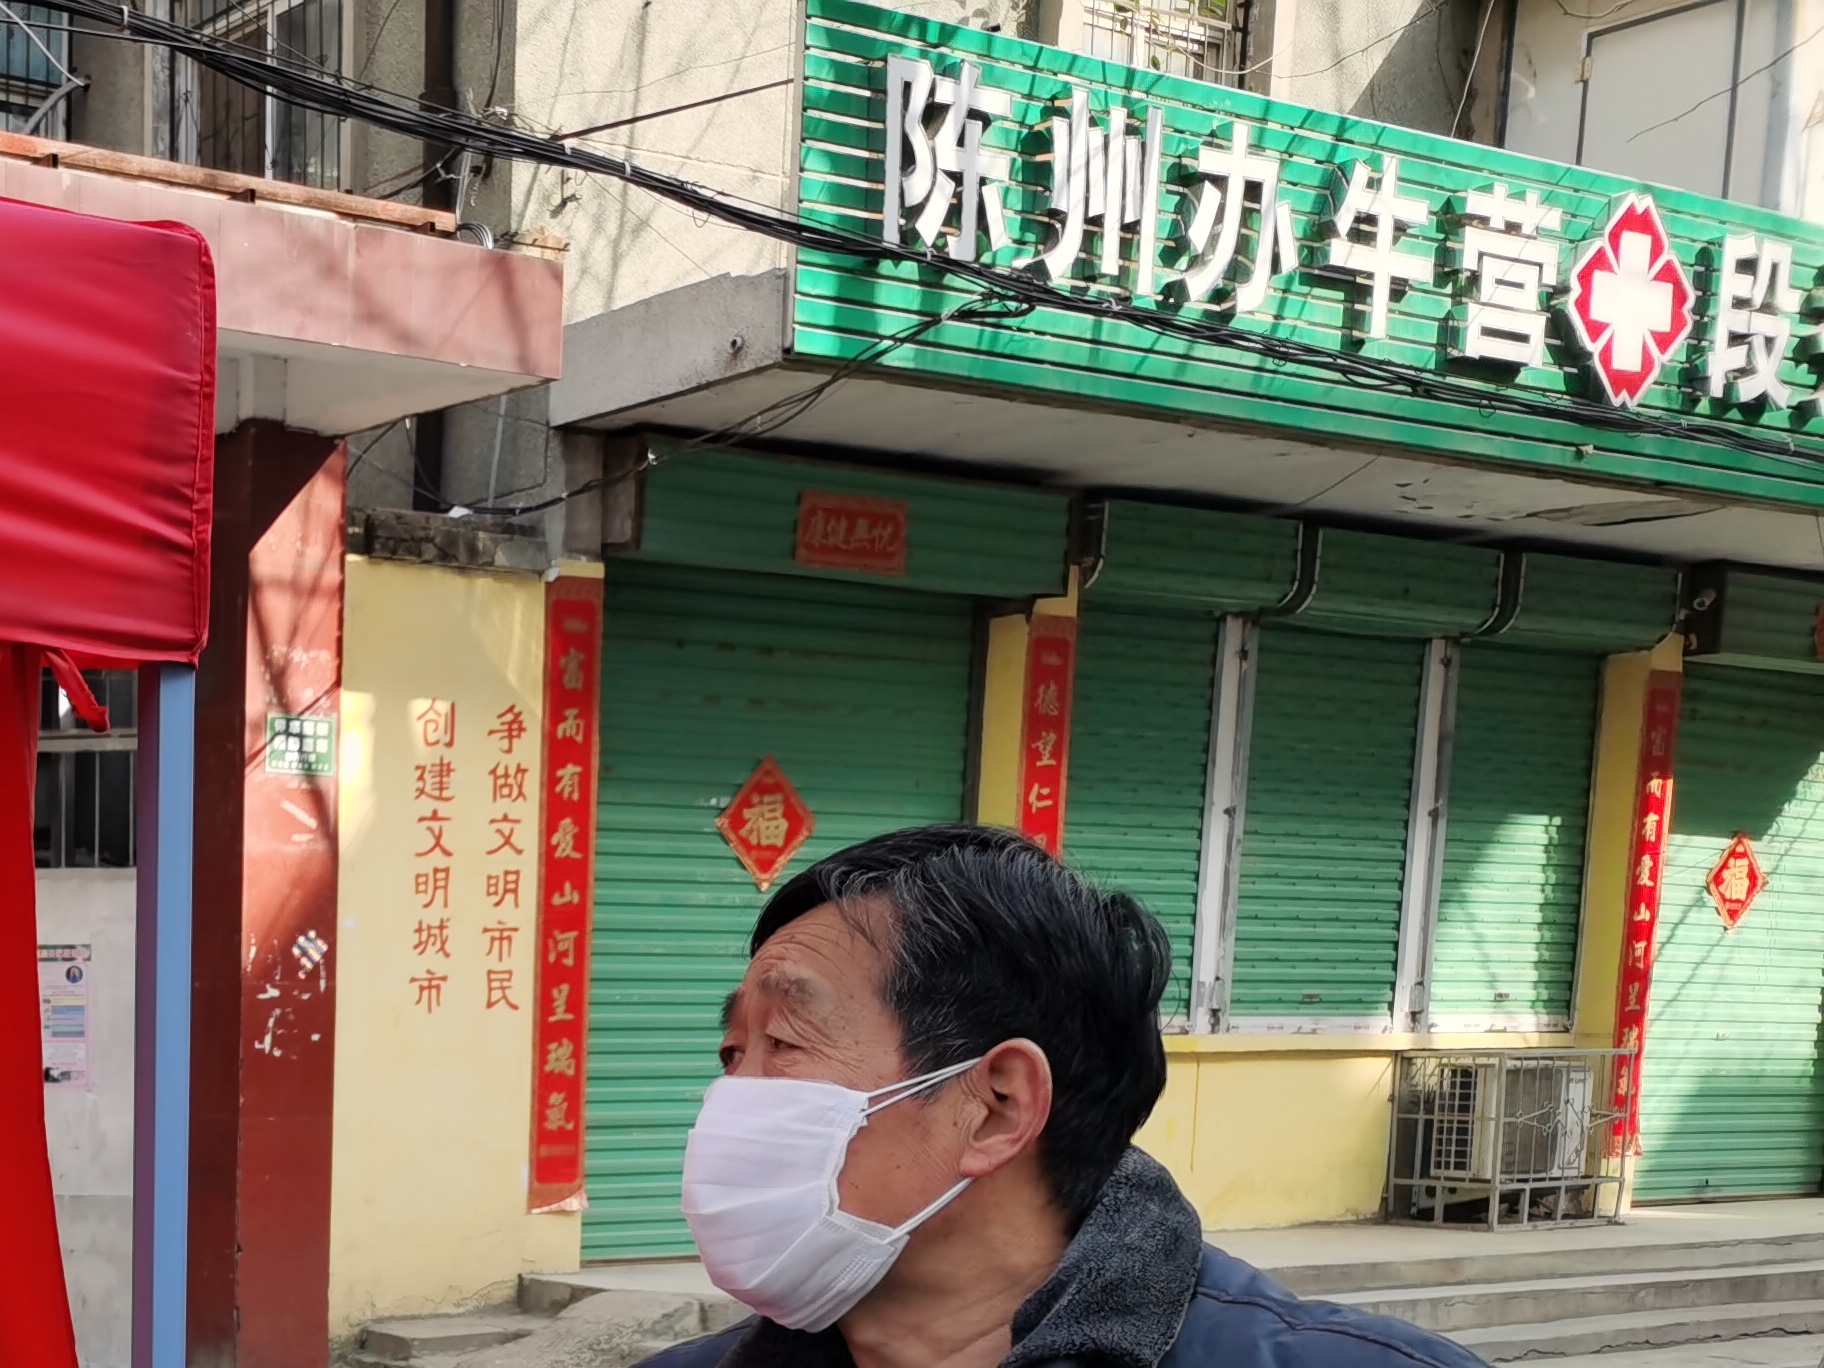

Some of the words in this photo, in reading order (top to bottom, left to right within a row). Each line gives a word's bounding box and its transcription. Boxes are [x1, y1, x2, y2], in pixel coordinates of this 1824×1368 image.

[883, 53, 1565, 369] 陈州办牛营
[1707, 232, 1824, 411] 段
[409, 698, 456, 1014] 创建文明城市
[482, 704, 529, 1011] 争做文明市民
[738, 792, 789, 848] 福
[1716, 857, 1751, 901] 福
